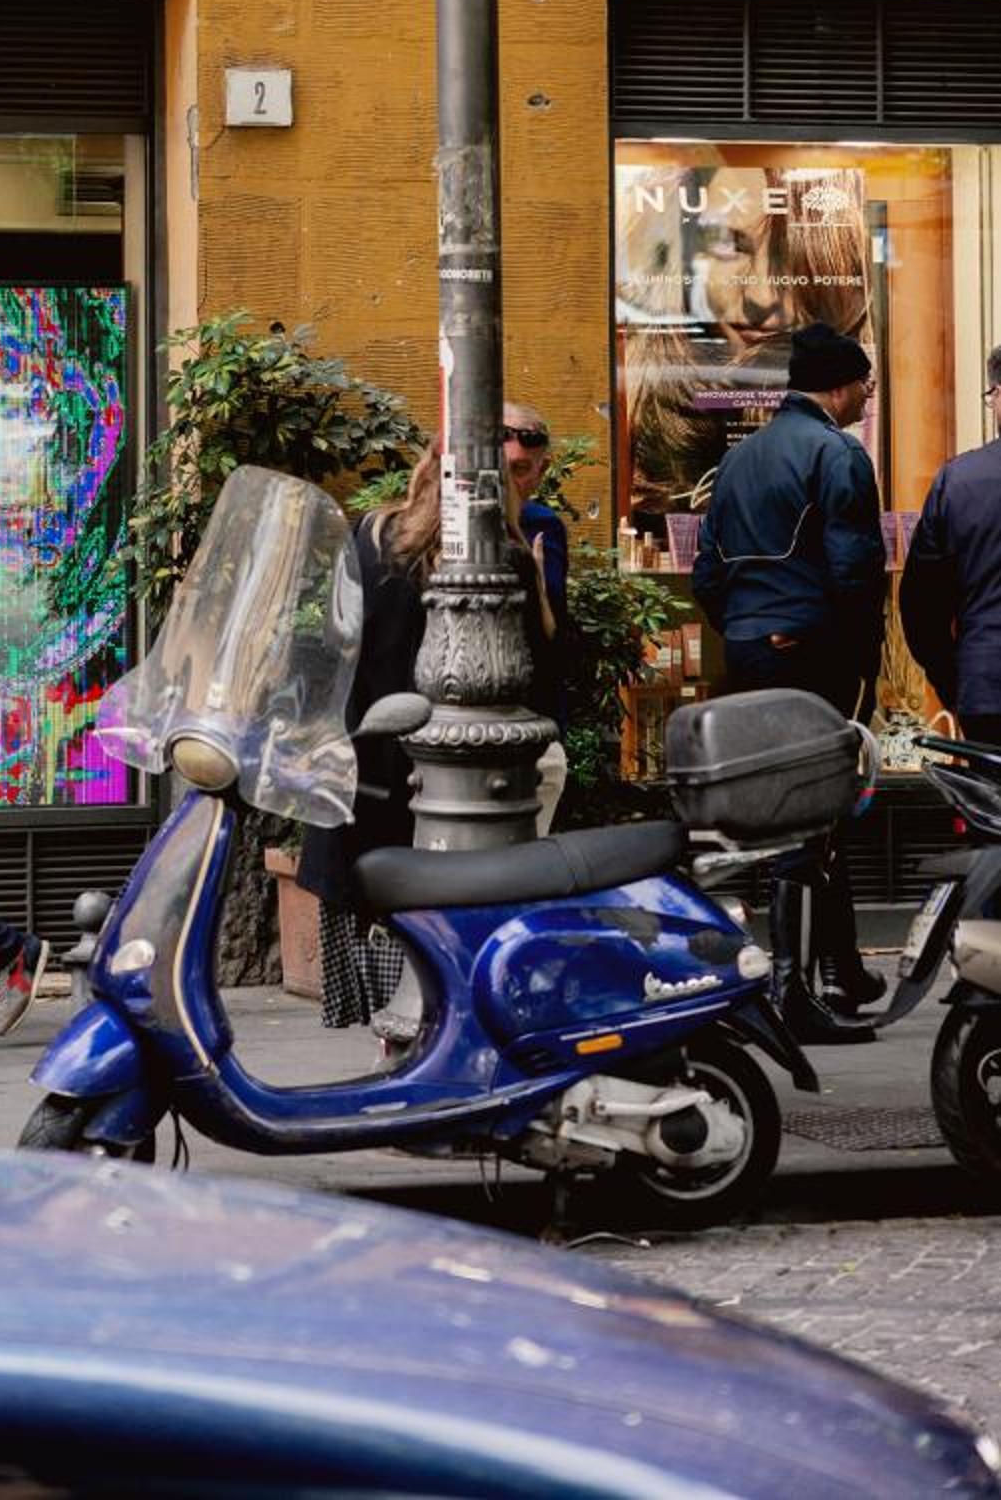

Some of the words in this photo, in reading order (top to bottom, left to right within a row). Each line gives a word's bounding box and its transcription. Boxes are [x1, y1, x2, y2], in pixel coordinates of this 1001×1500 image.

[253, 81, 267, 115] 2
[633, 185, 789, 215] NUXE
[763, 274, 810, 287] NUOVO
[813, 274, 863, 287] POTERE
